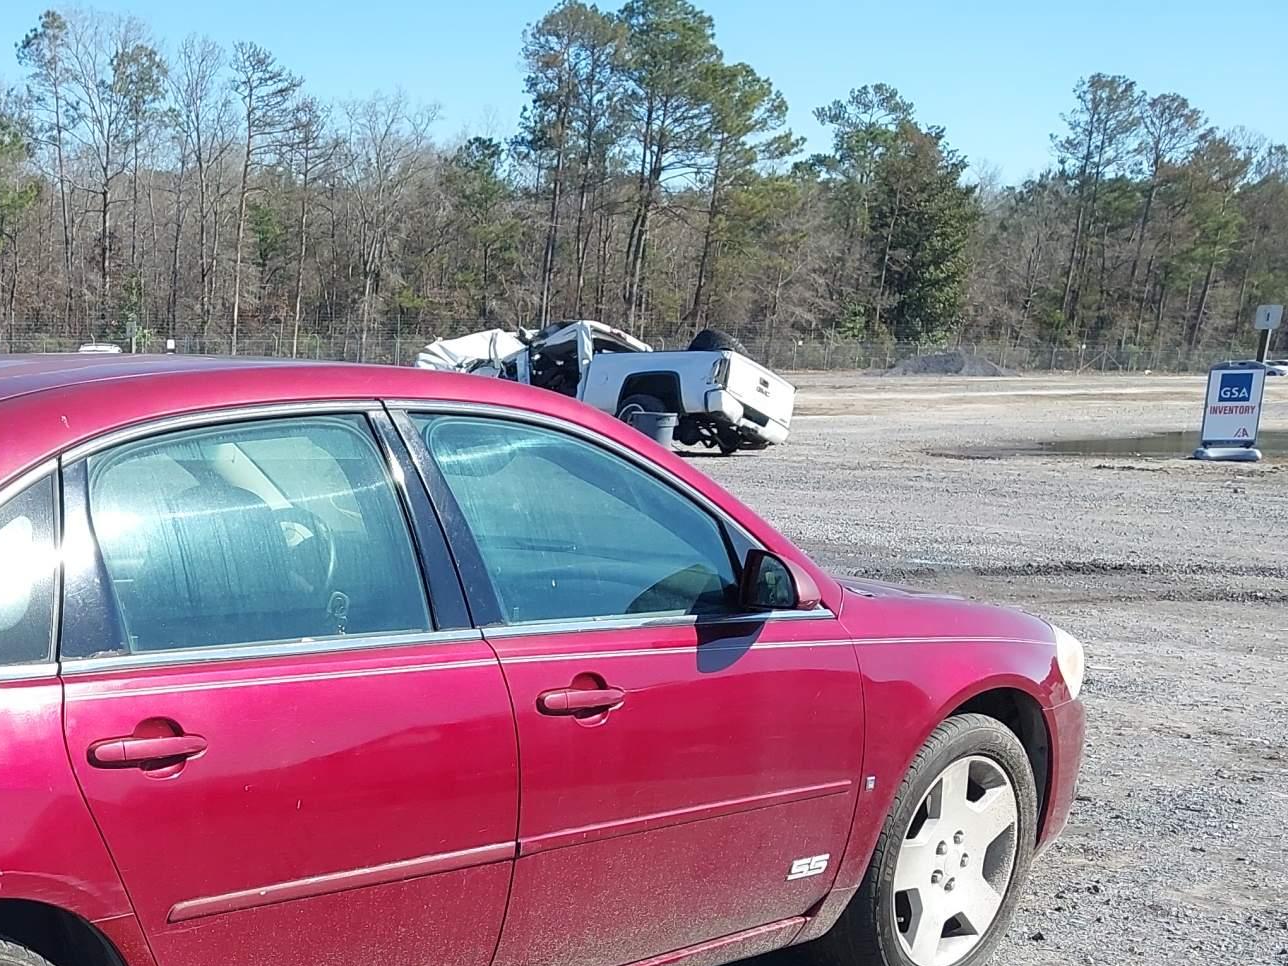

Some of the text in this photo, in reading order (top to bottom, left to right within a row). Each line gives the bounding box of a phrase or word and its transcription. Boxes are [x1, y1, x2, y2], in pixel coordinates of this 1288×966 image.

[1220, 387, 1249, 398] GSA
[1209, 405, 1256, 415] INVENTORY
[786, 853, 830, 881] SS
